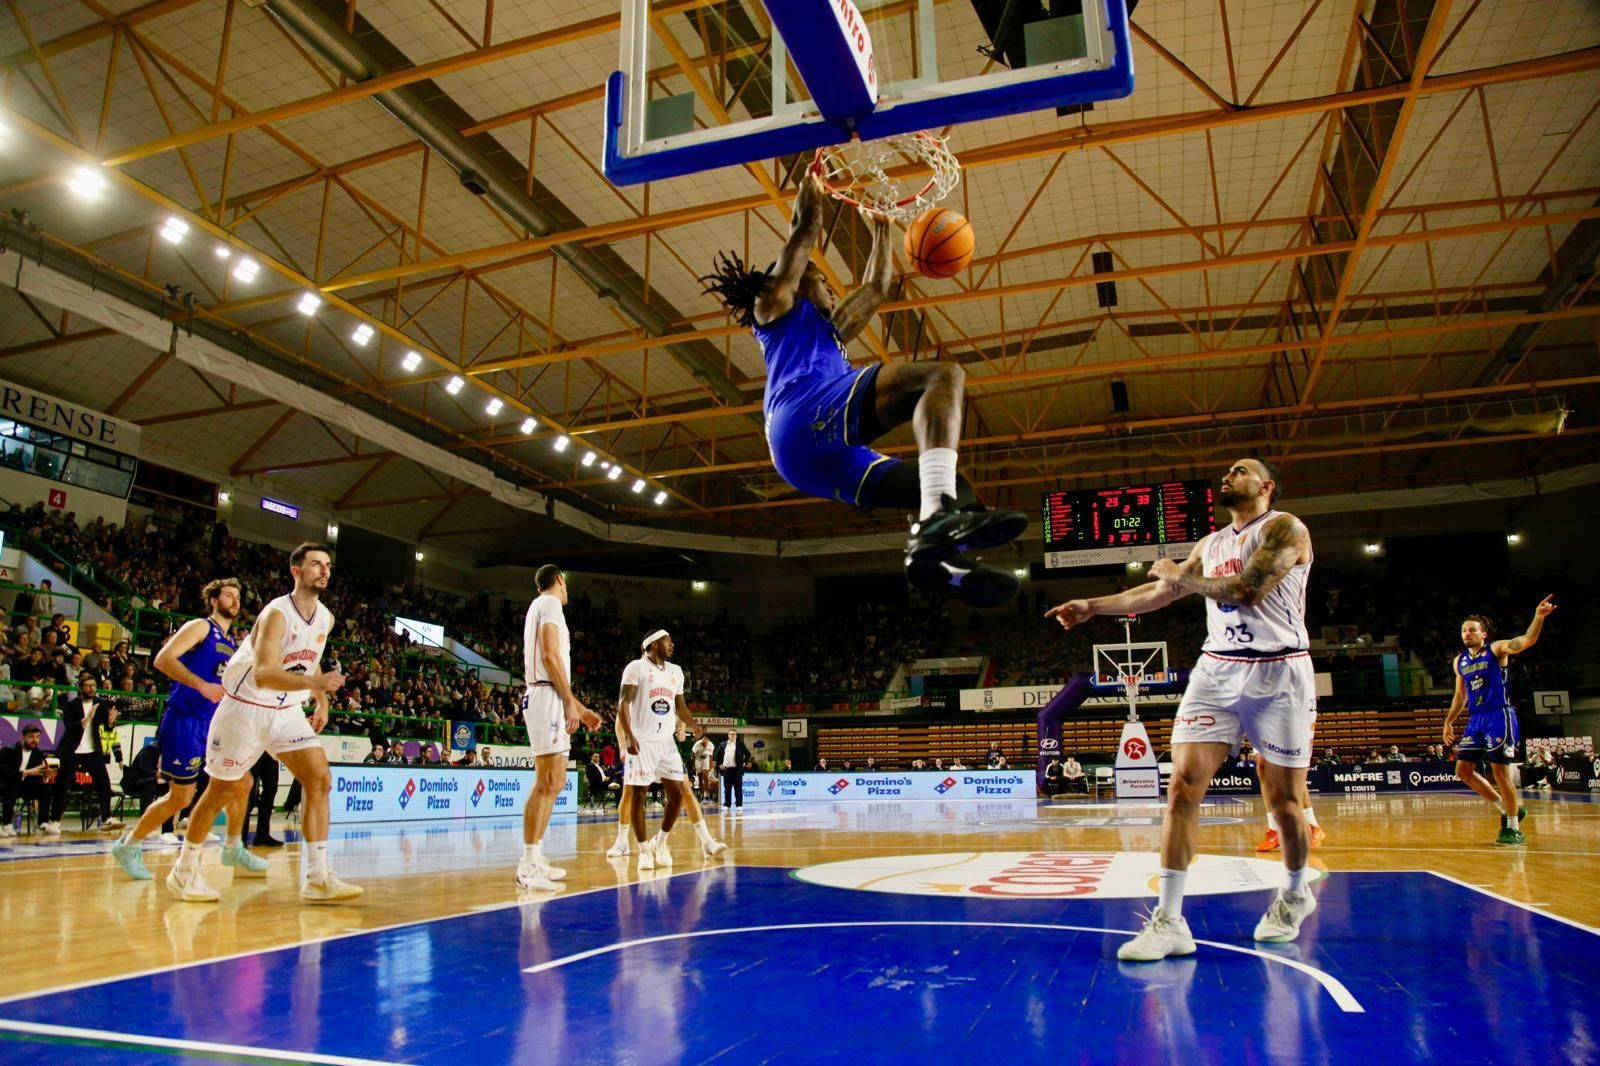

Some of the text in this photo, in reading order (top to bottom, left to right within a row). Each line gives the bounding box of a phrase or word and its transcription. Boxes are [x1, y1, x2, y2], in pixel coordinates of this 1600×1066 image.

[52, 492, 62, 506] 4
[1105, 494, 1151, 508] 23 33
[1122, 504, 1131, 513] 2
[1114, 517, 1141, 529] 07:22
[337, 775, 384, 793] Domino's
[855, 777, 912, 787] Domino's
[963, 775, 1023, 785] Domino's
[1334, 772, 1384, 783] MAPFRE
[419, 777, 459, 793] Domino's
[488, 778, 521, 792] Domino's
[867, 786, 901, 796] Pizza
[976, 785, 1011, 795] Pizza
[346, 795, 374, 812] Pizza
[427, 795, 450, 809] Pizza
[494, 794, 514, 808] Pizza
